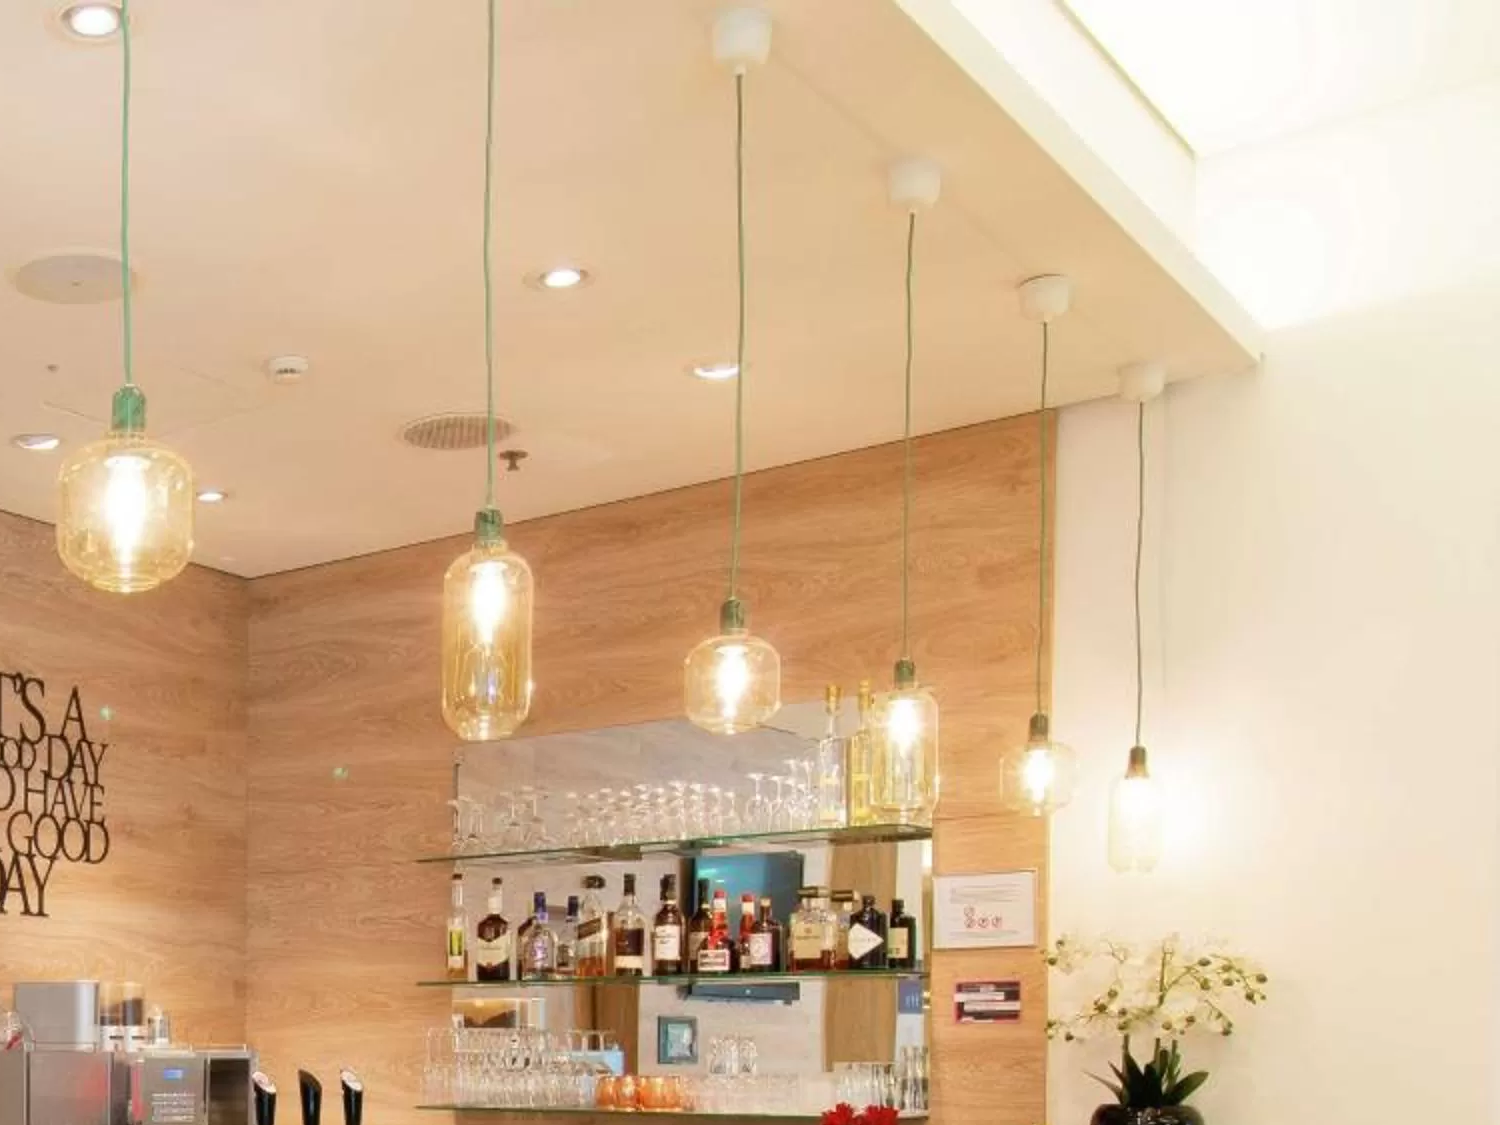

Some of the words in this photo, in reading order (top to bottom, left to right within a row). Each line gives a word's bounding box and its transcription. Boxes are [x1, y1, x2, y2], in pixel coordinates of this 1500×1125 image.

[58, 685, 88, 740] A
[43, 733, 108, 785] DAY
[19, 768, 105, 824] HAVE
[7, 810, 109, 864] GOOD
